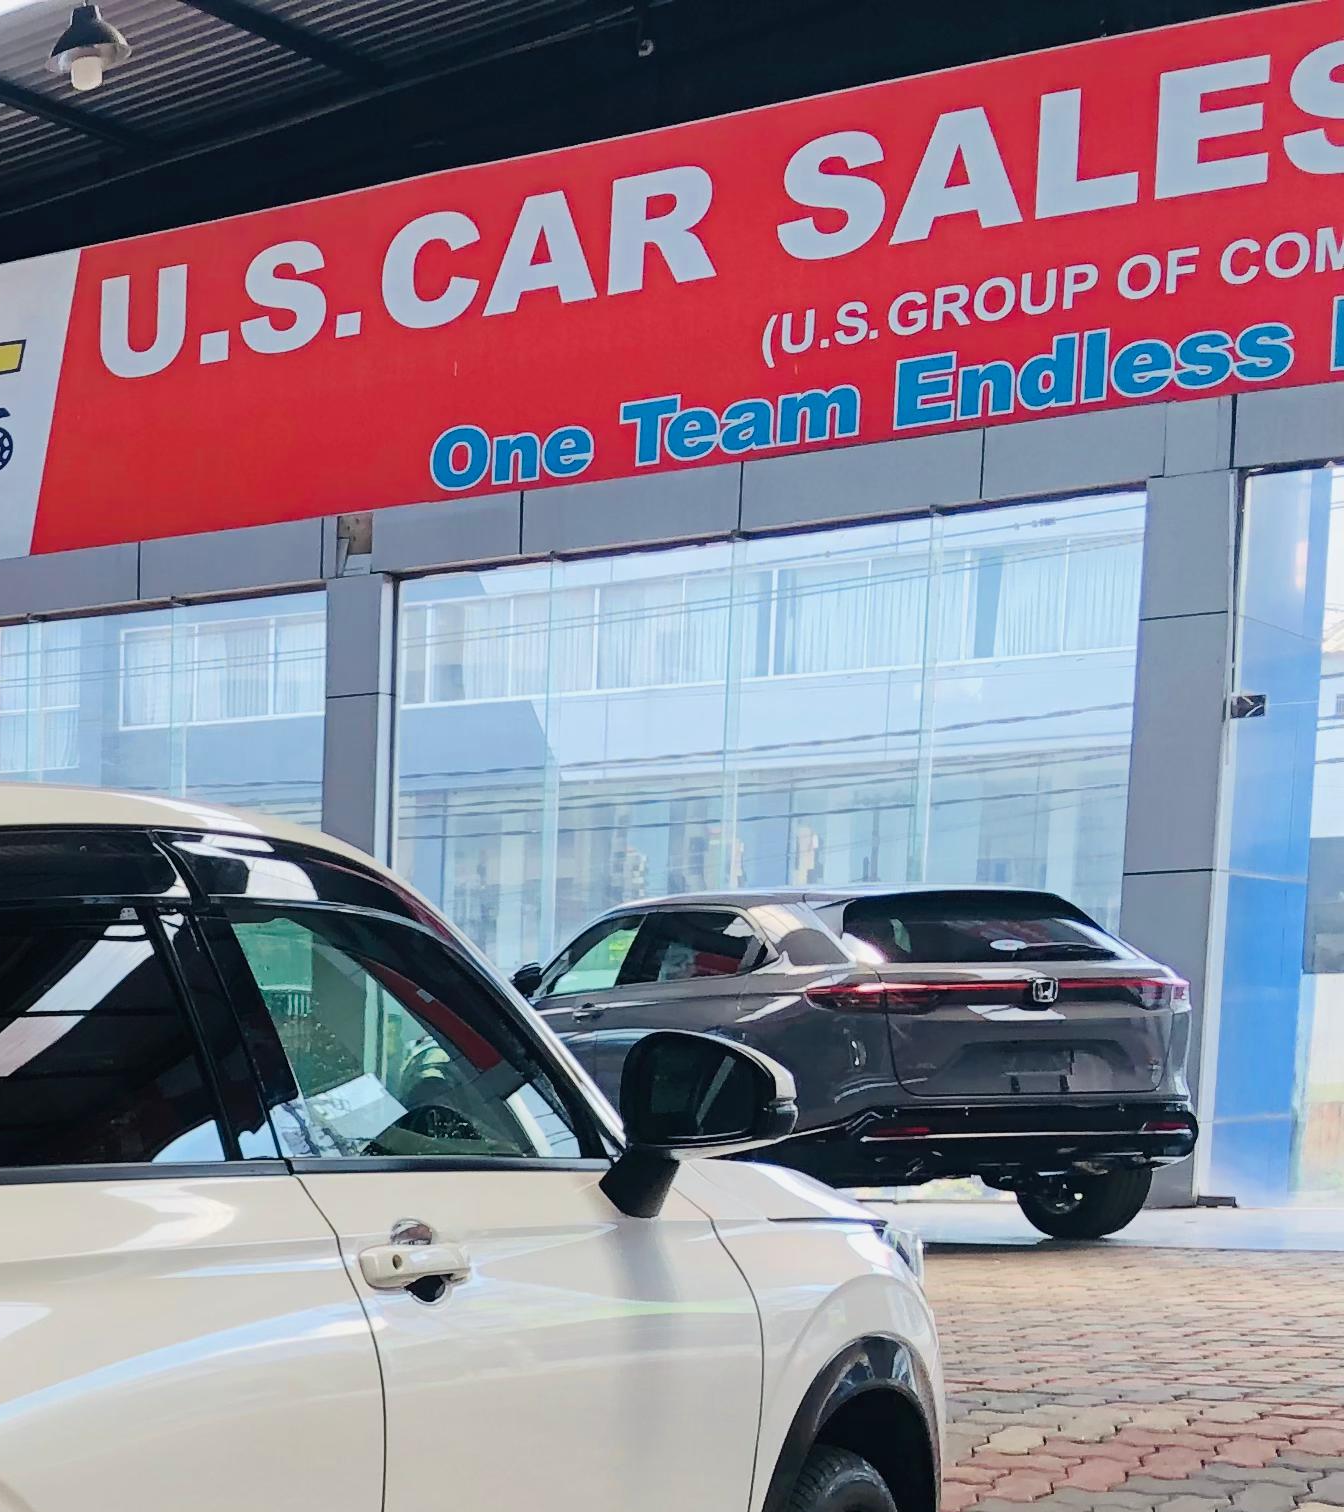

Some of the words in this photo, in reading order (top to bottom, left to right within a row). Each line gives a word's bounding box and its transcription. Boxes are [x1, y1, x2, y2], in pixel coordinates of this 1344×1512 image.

[1116, 247, 1200, 304] OF
[430, 417, 596, 492] One
[620, 378, 860, 468] Team
[893, 316, 1295, 433] Endless
